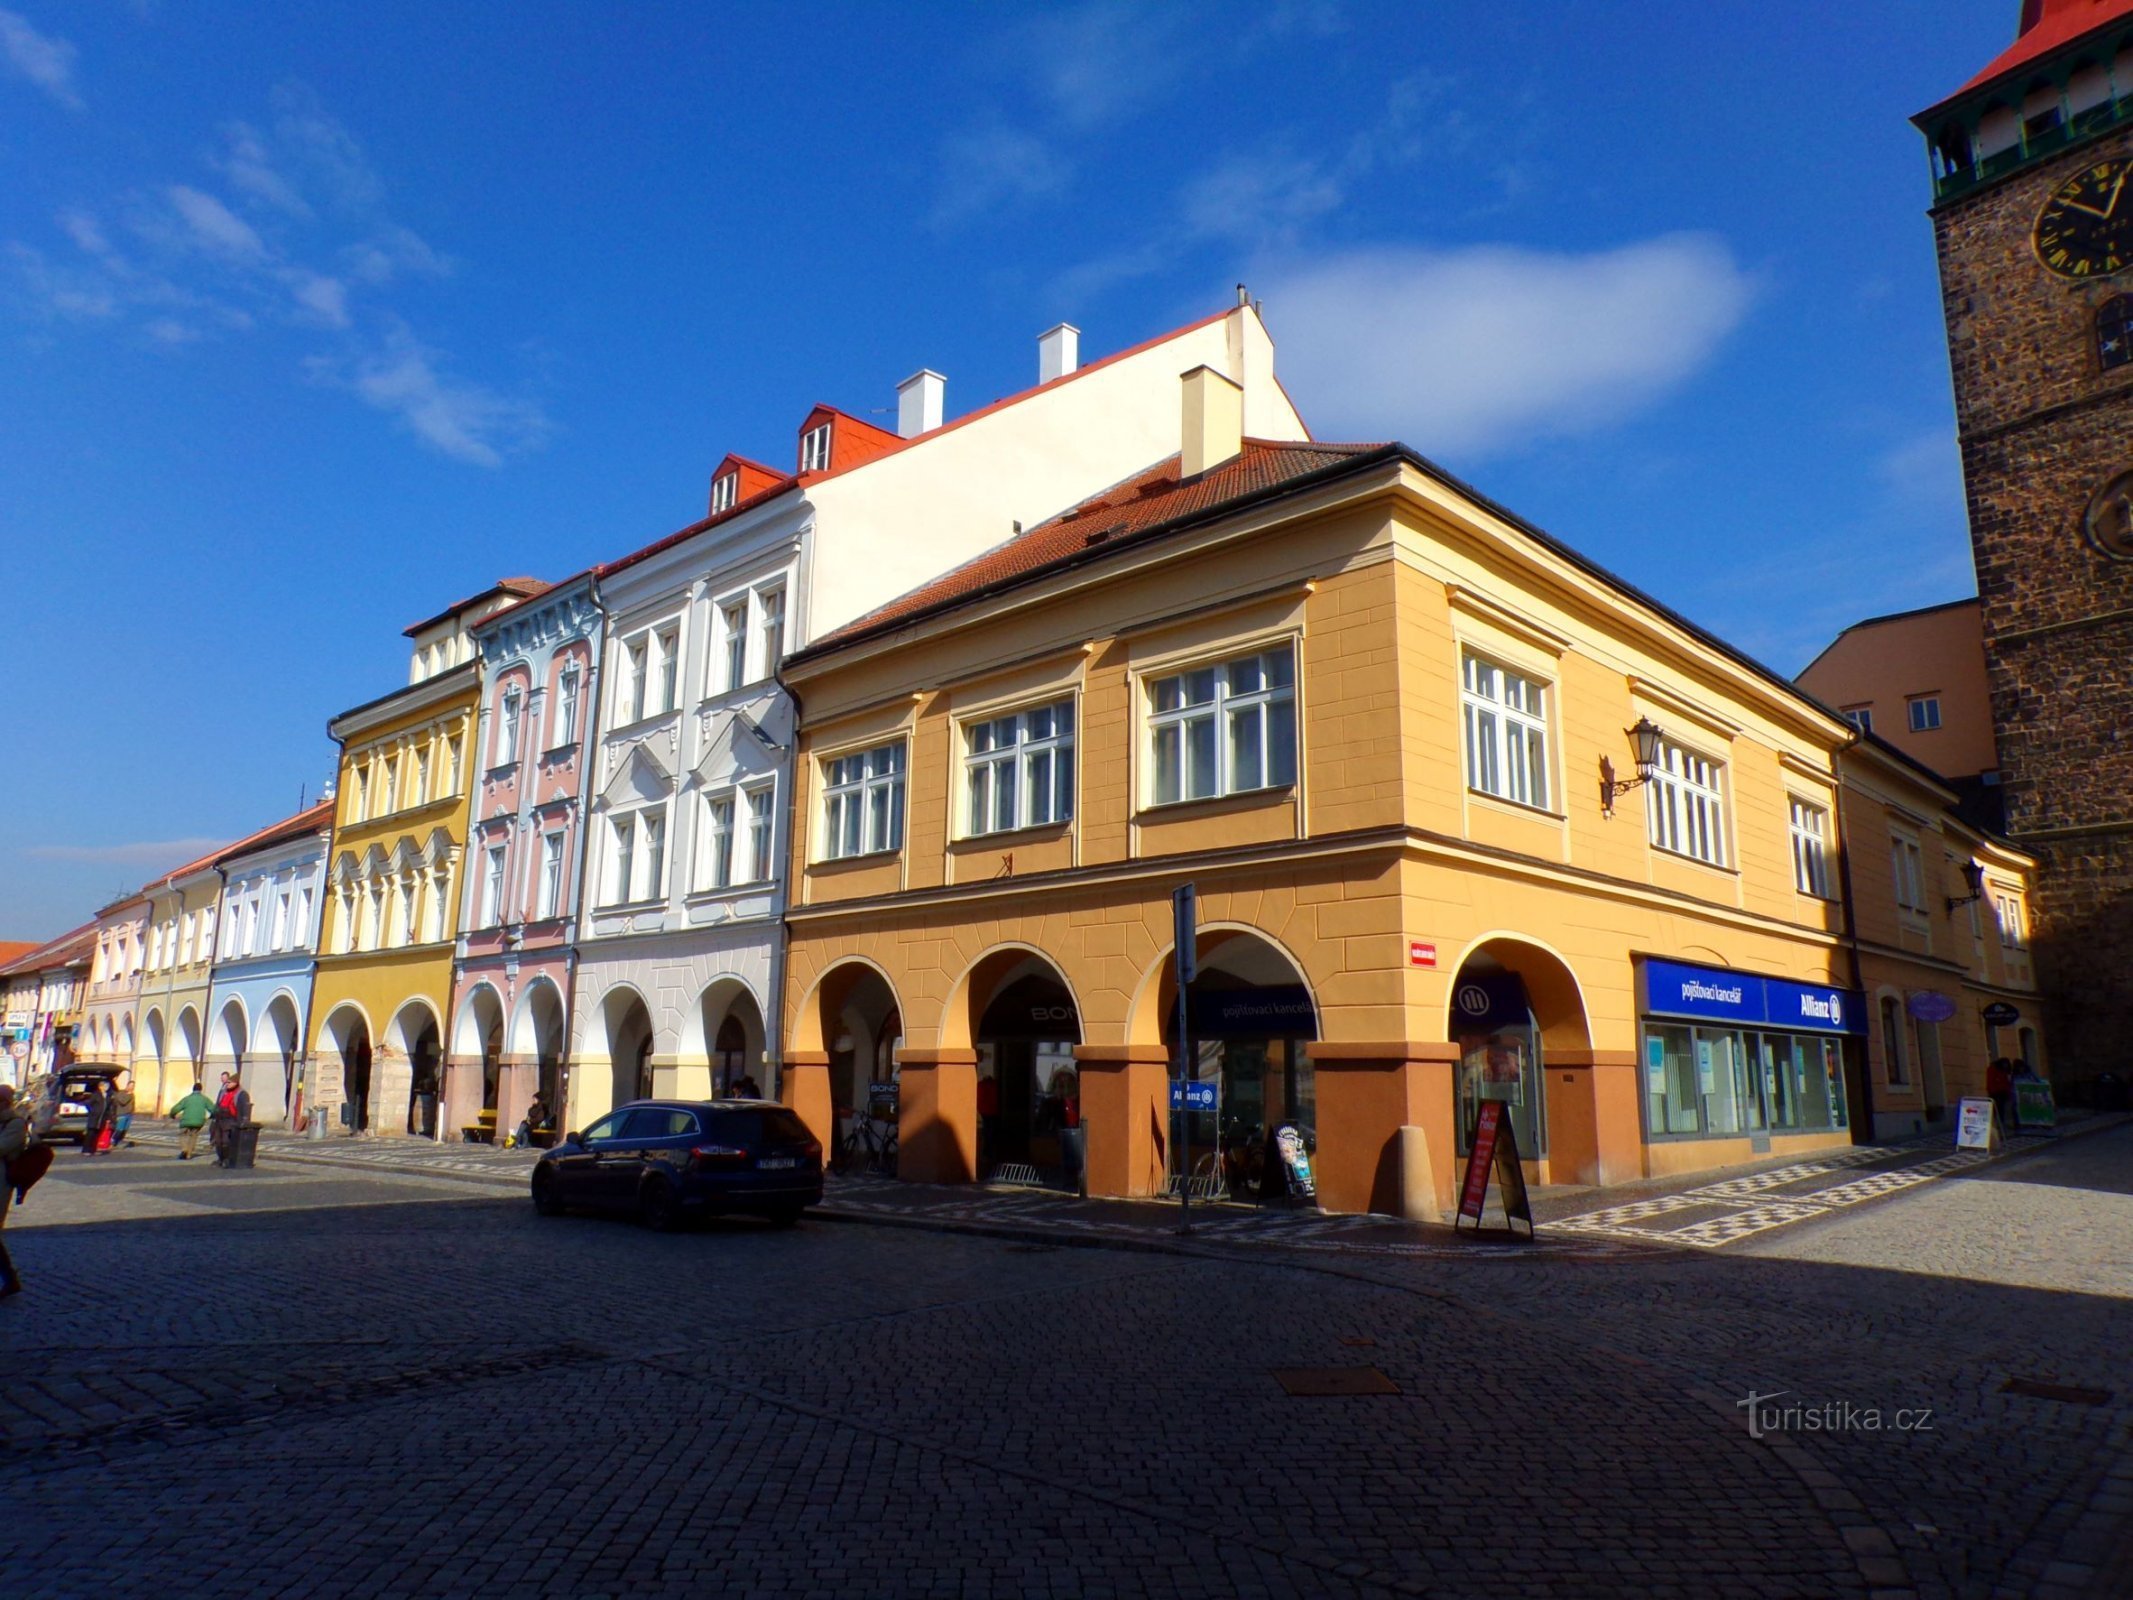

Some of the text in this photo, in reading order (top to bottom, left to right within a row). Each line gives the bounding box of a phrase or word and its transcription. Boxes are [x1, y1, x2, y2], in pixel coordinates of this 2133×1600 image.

[1682, 980, 1741, 1004] pojišťovací kancelář
[1801, 994, 1829, 1018] Allianz
